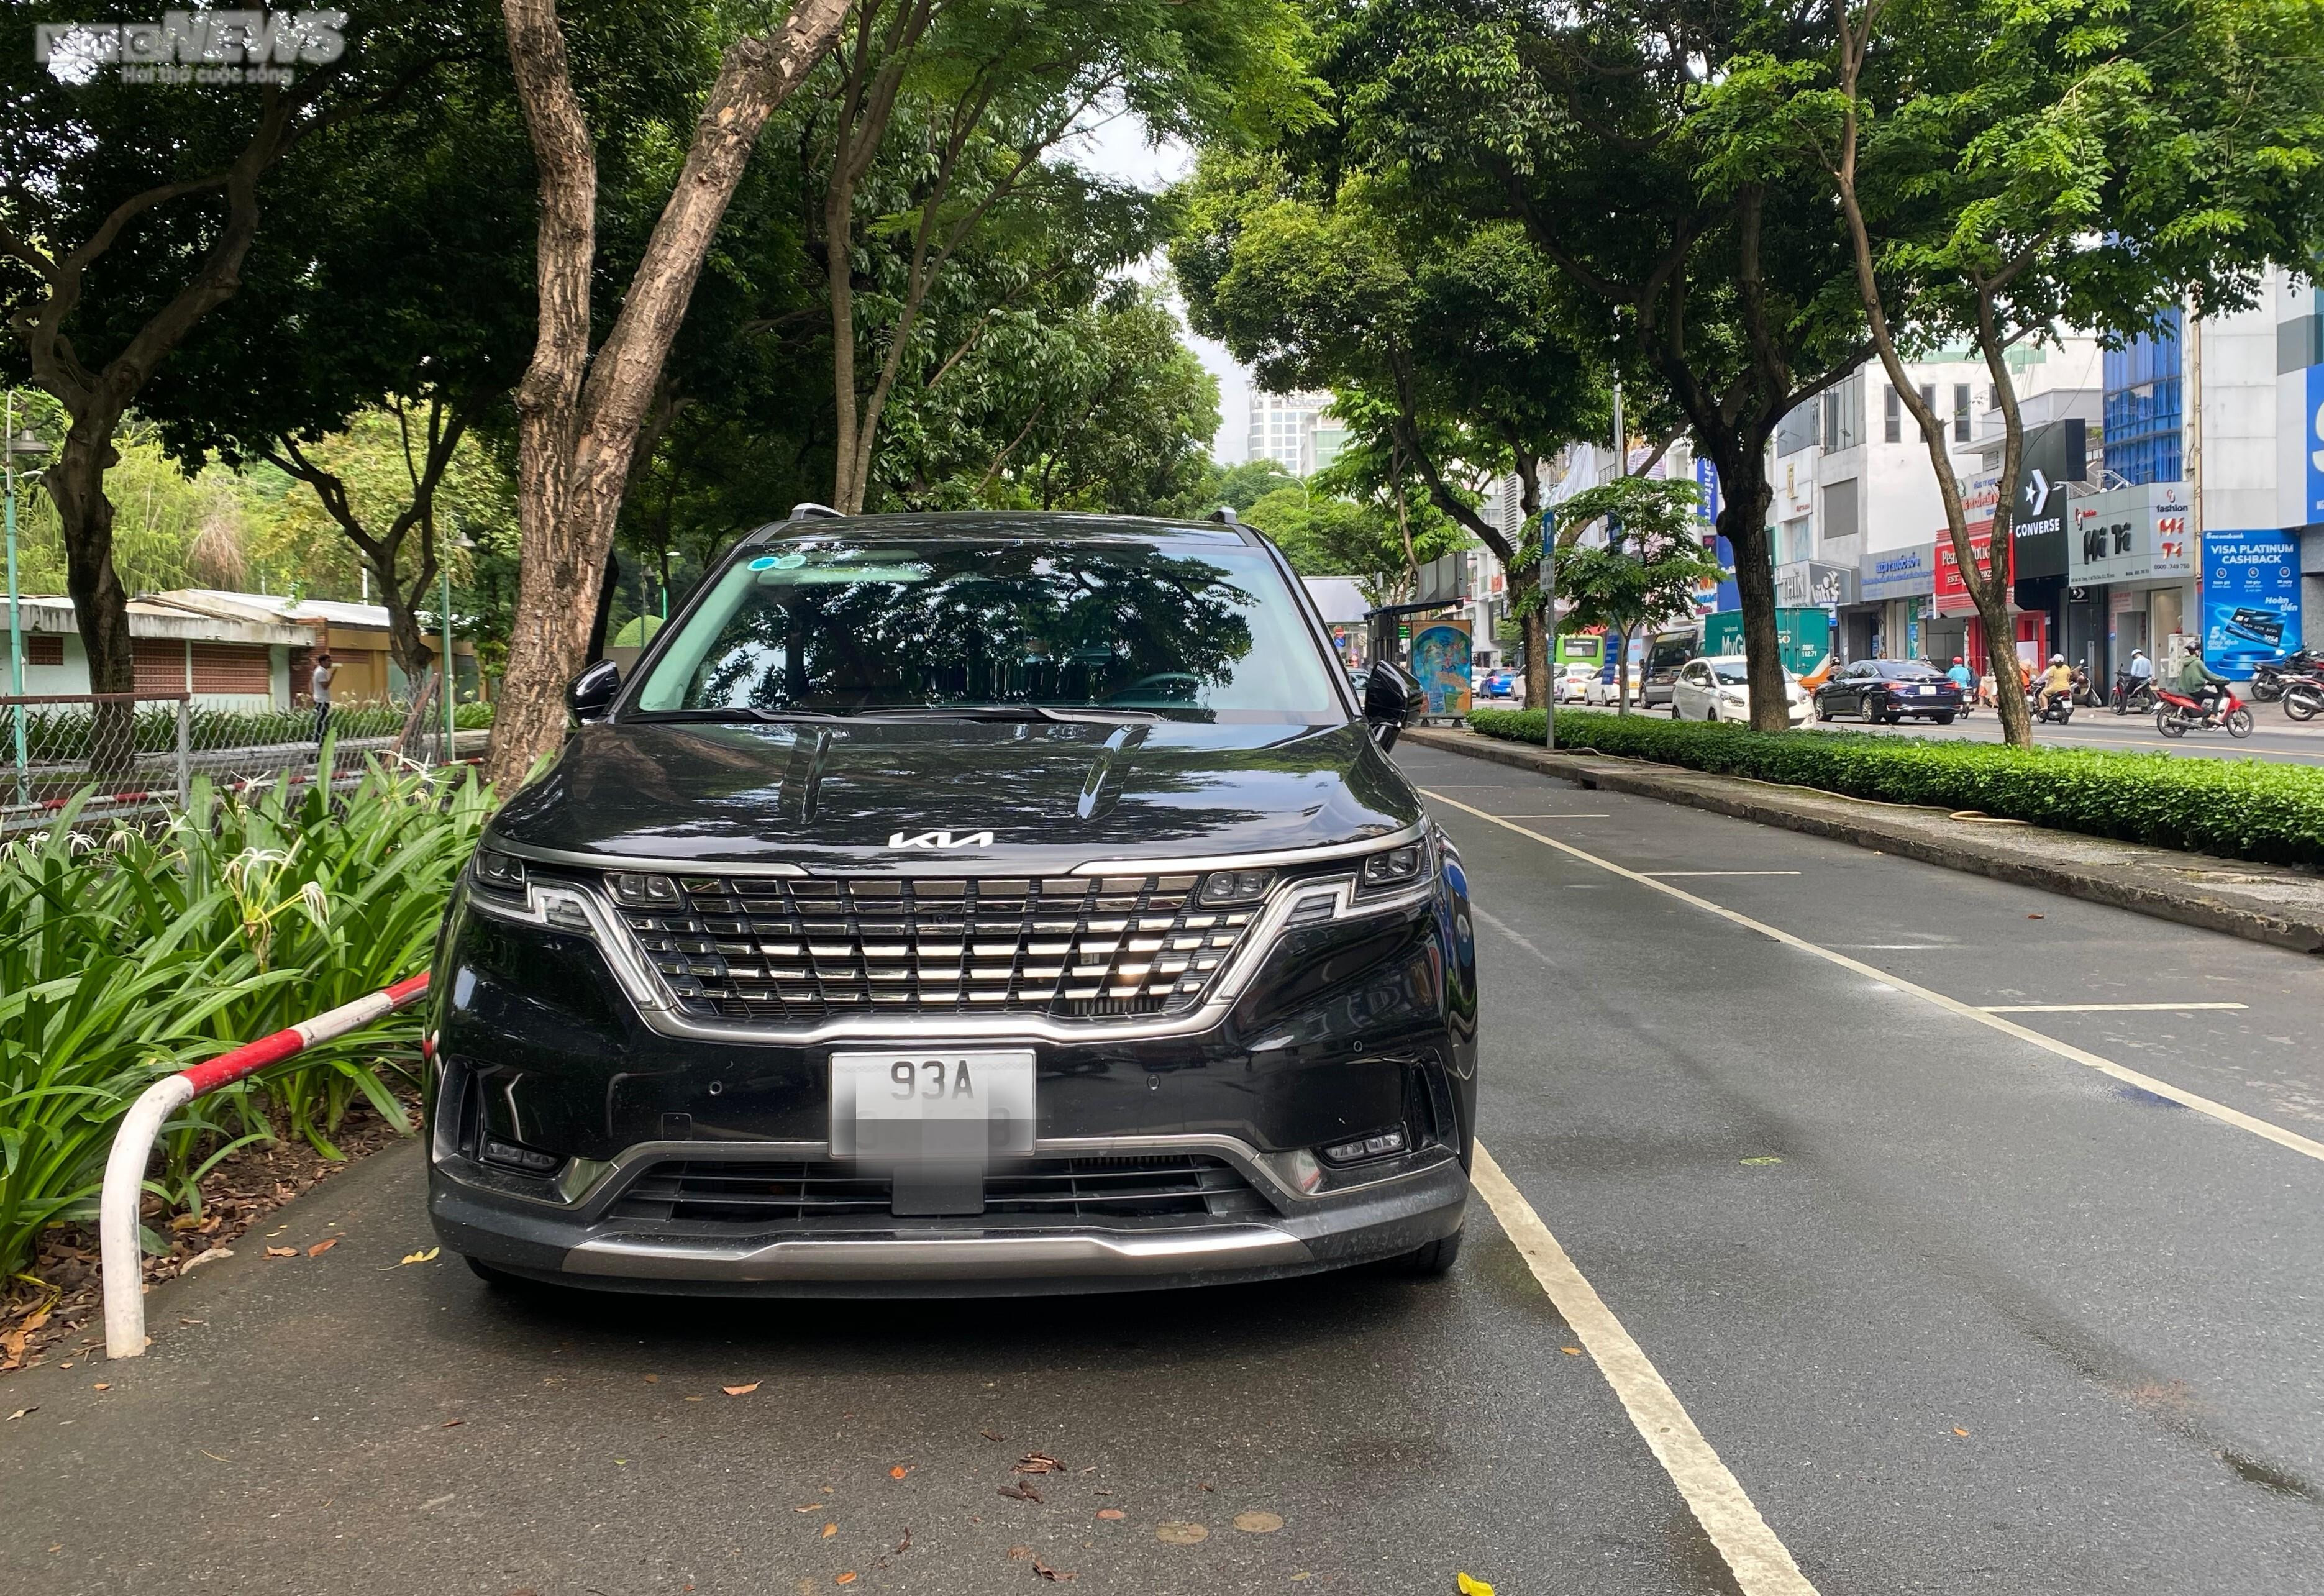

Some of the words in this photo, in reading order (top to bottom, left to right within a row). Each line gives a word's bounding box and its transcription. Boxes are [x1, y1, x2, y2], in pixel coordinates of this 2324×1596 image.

[2016, 518, 2060, 537] CONVERSE
[2210, 545, 2237, 554] VISA
[2240, 544, 2294, 554] PLATINUM
[2221, 555, 2282, 564] CASHBACK
[2264, 634, 2279, 642] VISA
[888, 831, 994, 849] KIA
[891, 1060, 975, 1100] 93A
